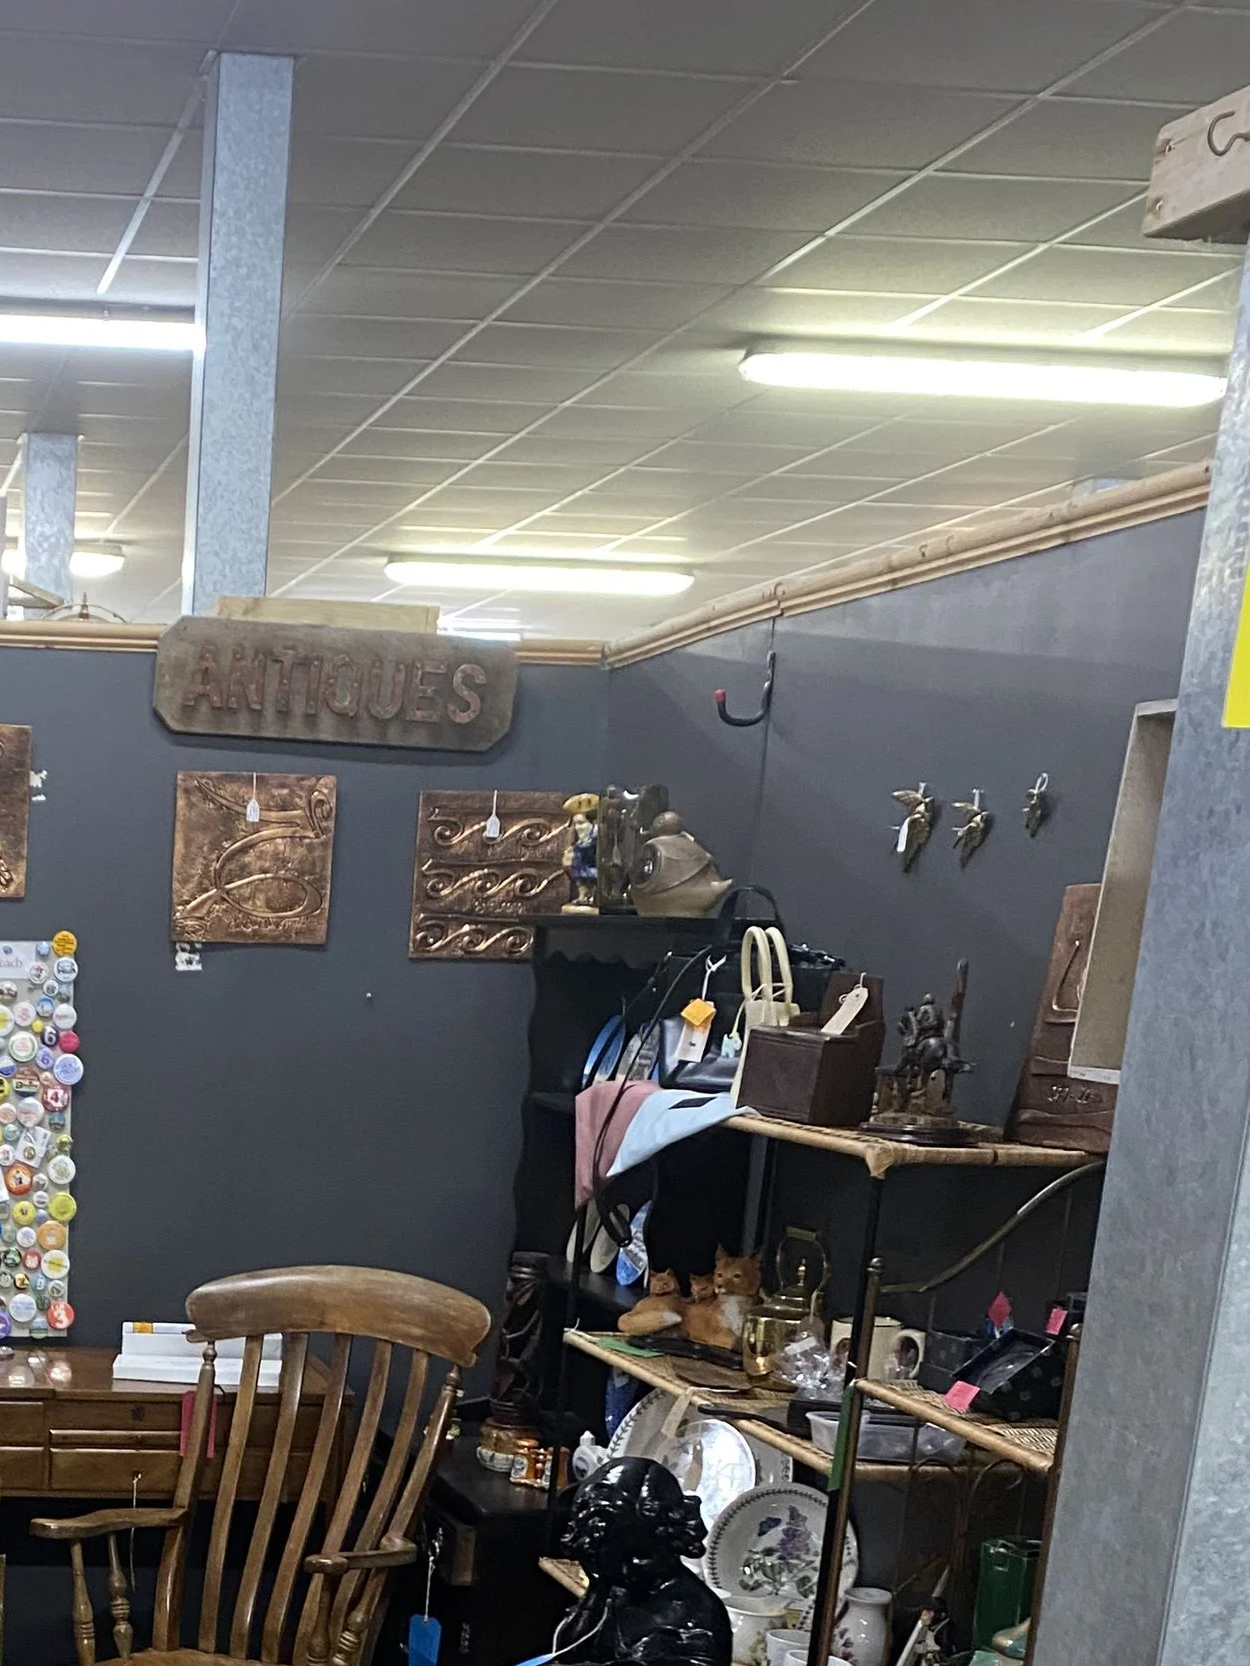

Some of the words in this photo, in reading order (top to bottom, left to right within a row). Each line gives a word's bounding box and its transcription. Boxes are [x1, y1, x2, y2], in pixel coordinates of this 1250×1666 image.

[184, 644, 488, 725] ANTIQUES
[0, 956, 23, 969] each
[44, 1026, 57, 1045] 6
